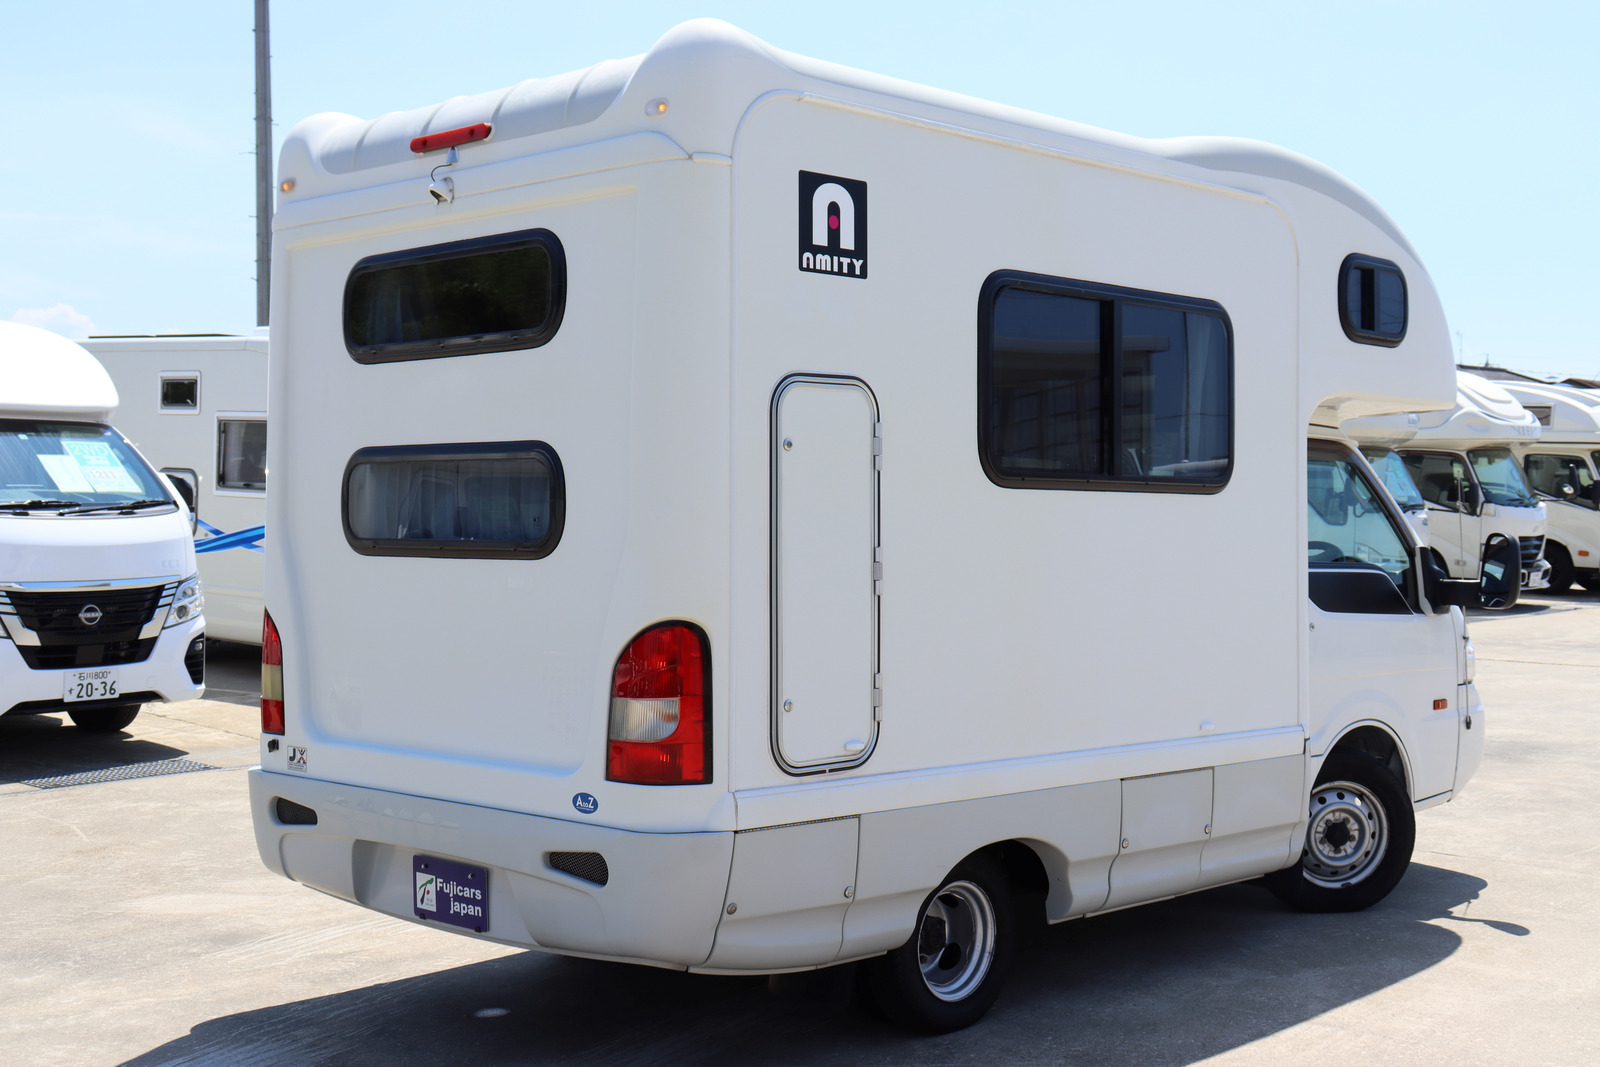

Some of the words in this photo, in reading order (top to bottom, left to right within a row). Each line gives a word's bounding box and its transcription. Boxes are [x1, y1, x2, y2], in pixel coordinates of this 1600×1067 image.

[802, 251, 864, 275] AMITY
[70, 444, 108, 456] 2WD
[76, 680, 116, 699] 20-36
[436, 878, 482, 900] Fujicars
[449, 898, 482, 917] japan
